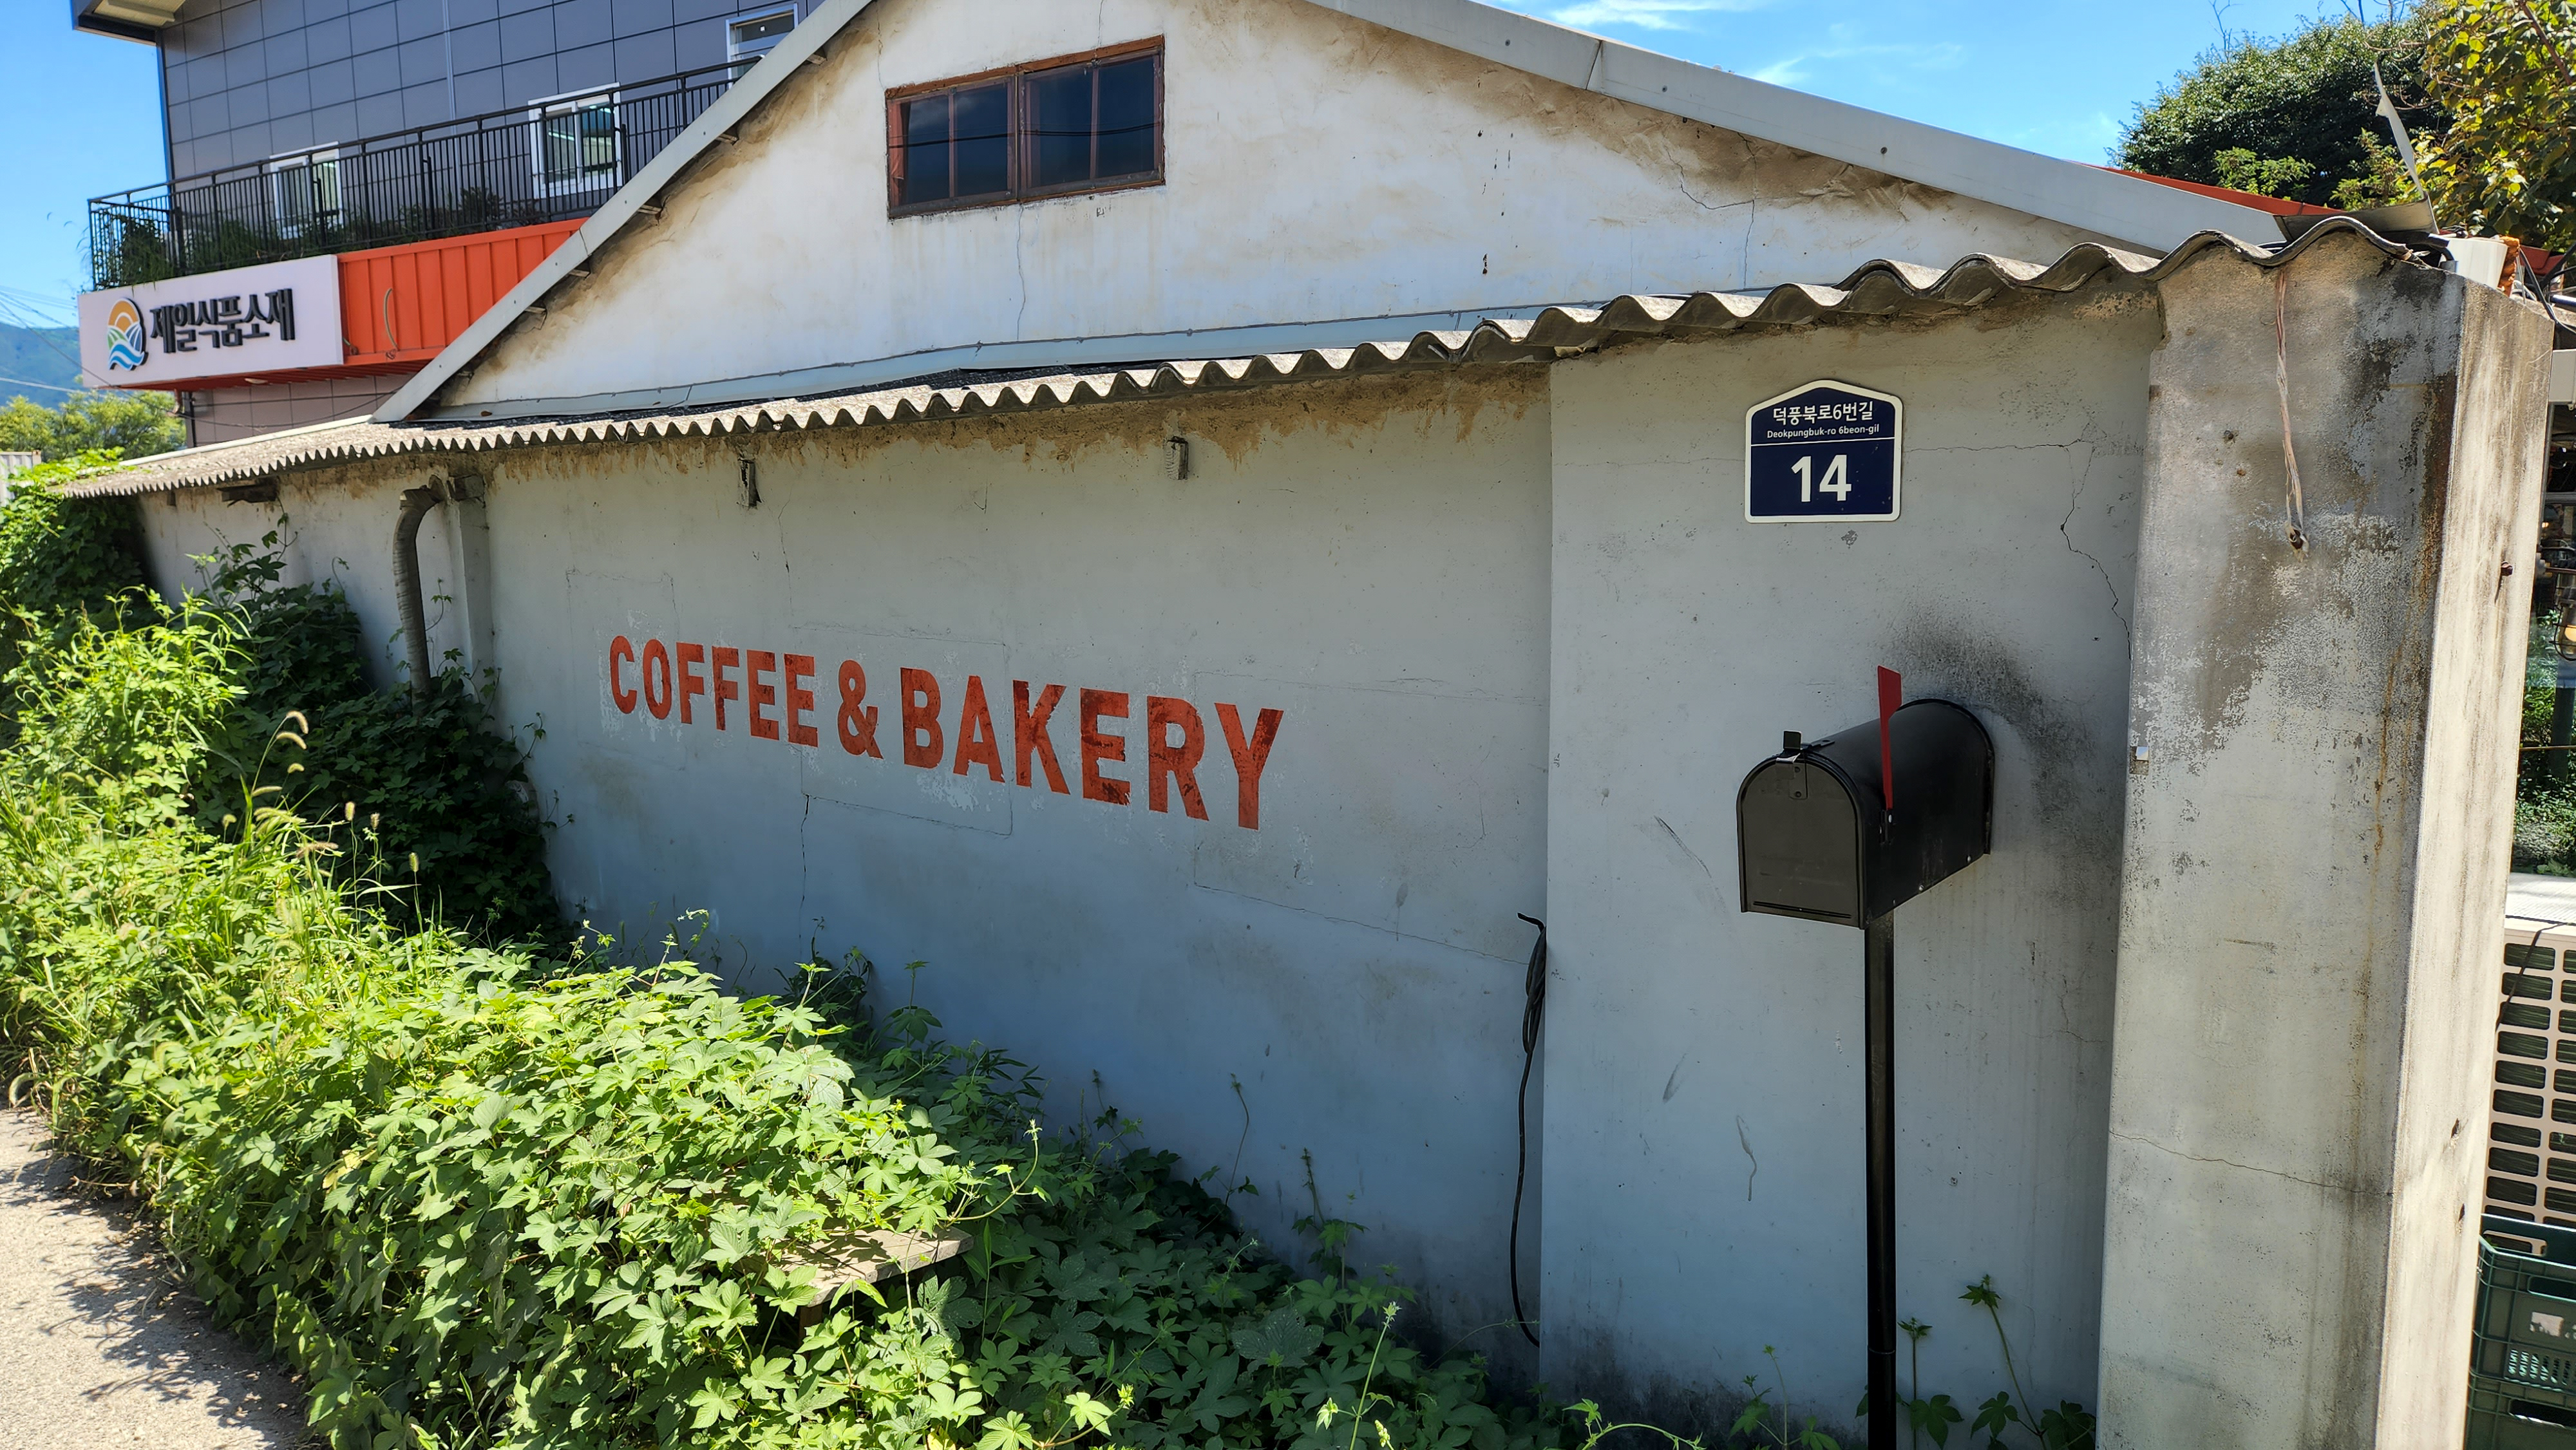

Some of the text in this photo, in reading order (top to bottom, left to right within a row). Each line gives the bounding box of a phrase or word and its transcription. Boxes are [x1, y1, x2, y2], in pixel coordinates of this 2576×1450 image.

[149, 288, 296, 353] 제일식품소재
[1766, 424, 1879, 439] Deokpungbuk-ro 6beon-gil
[1773, 400, 1873, 426] 덕풍북로6번길
[1791, 454, 1852, 502] 14
[609, 634, 1283, 830] COFFEE & BAKERY
